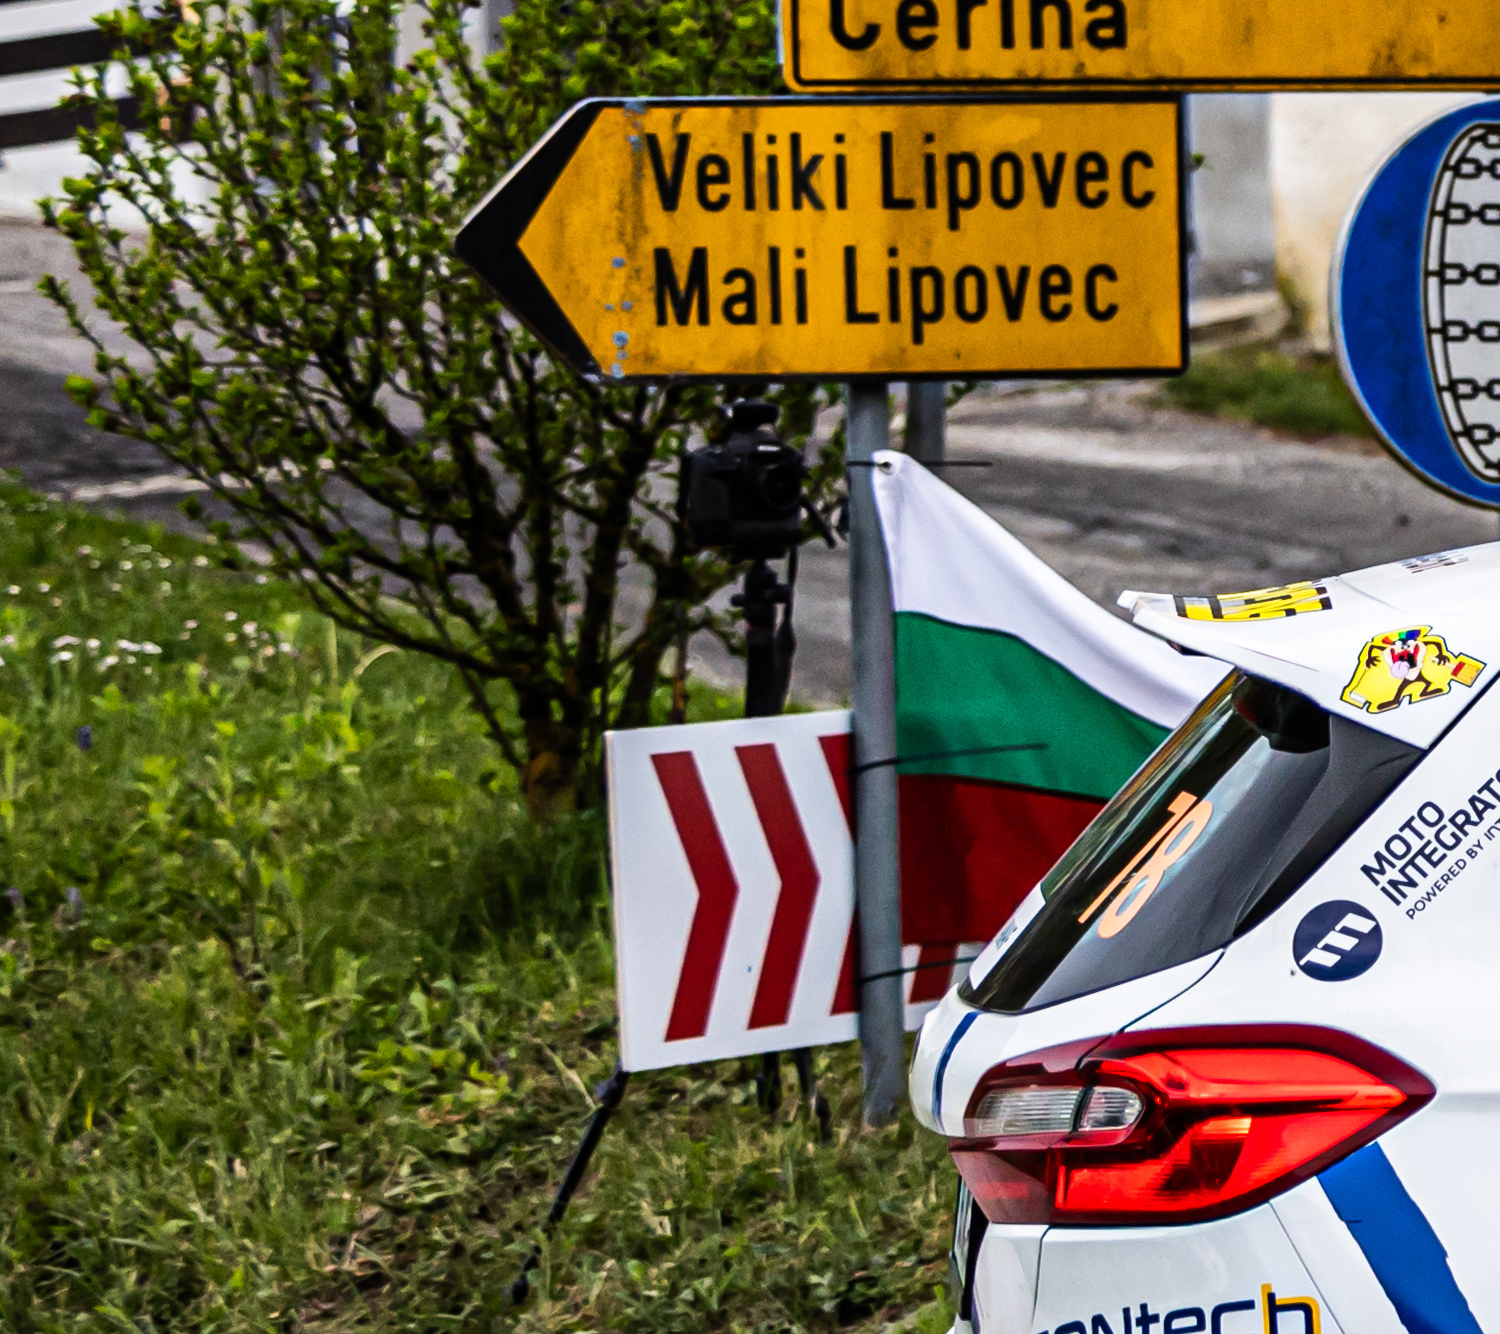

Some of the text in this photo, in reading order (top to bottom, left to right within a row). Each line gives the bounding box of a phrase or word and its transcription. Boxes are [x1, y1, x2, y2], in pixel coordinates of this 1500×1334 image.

[644, 131, 1157, 231] Veliki Lipovec
[652, 246, 1121, 345] Mali Lipovec
[1359, 799, 1445, 888] MOTO
[1405, 857, 1468, 920] POWERED
[1465, 839, 1487, 861] BY
